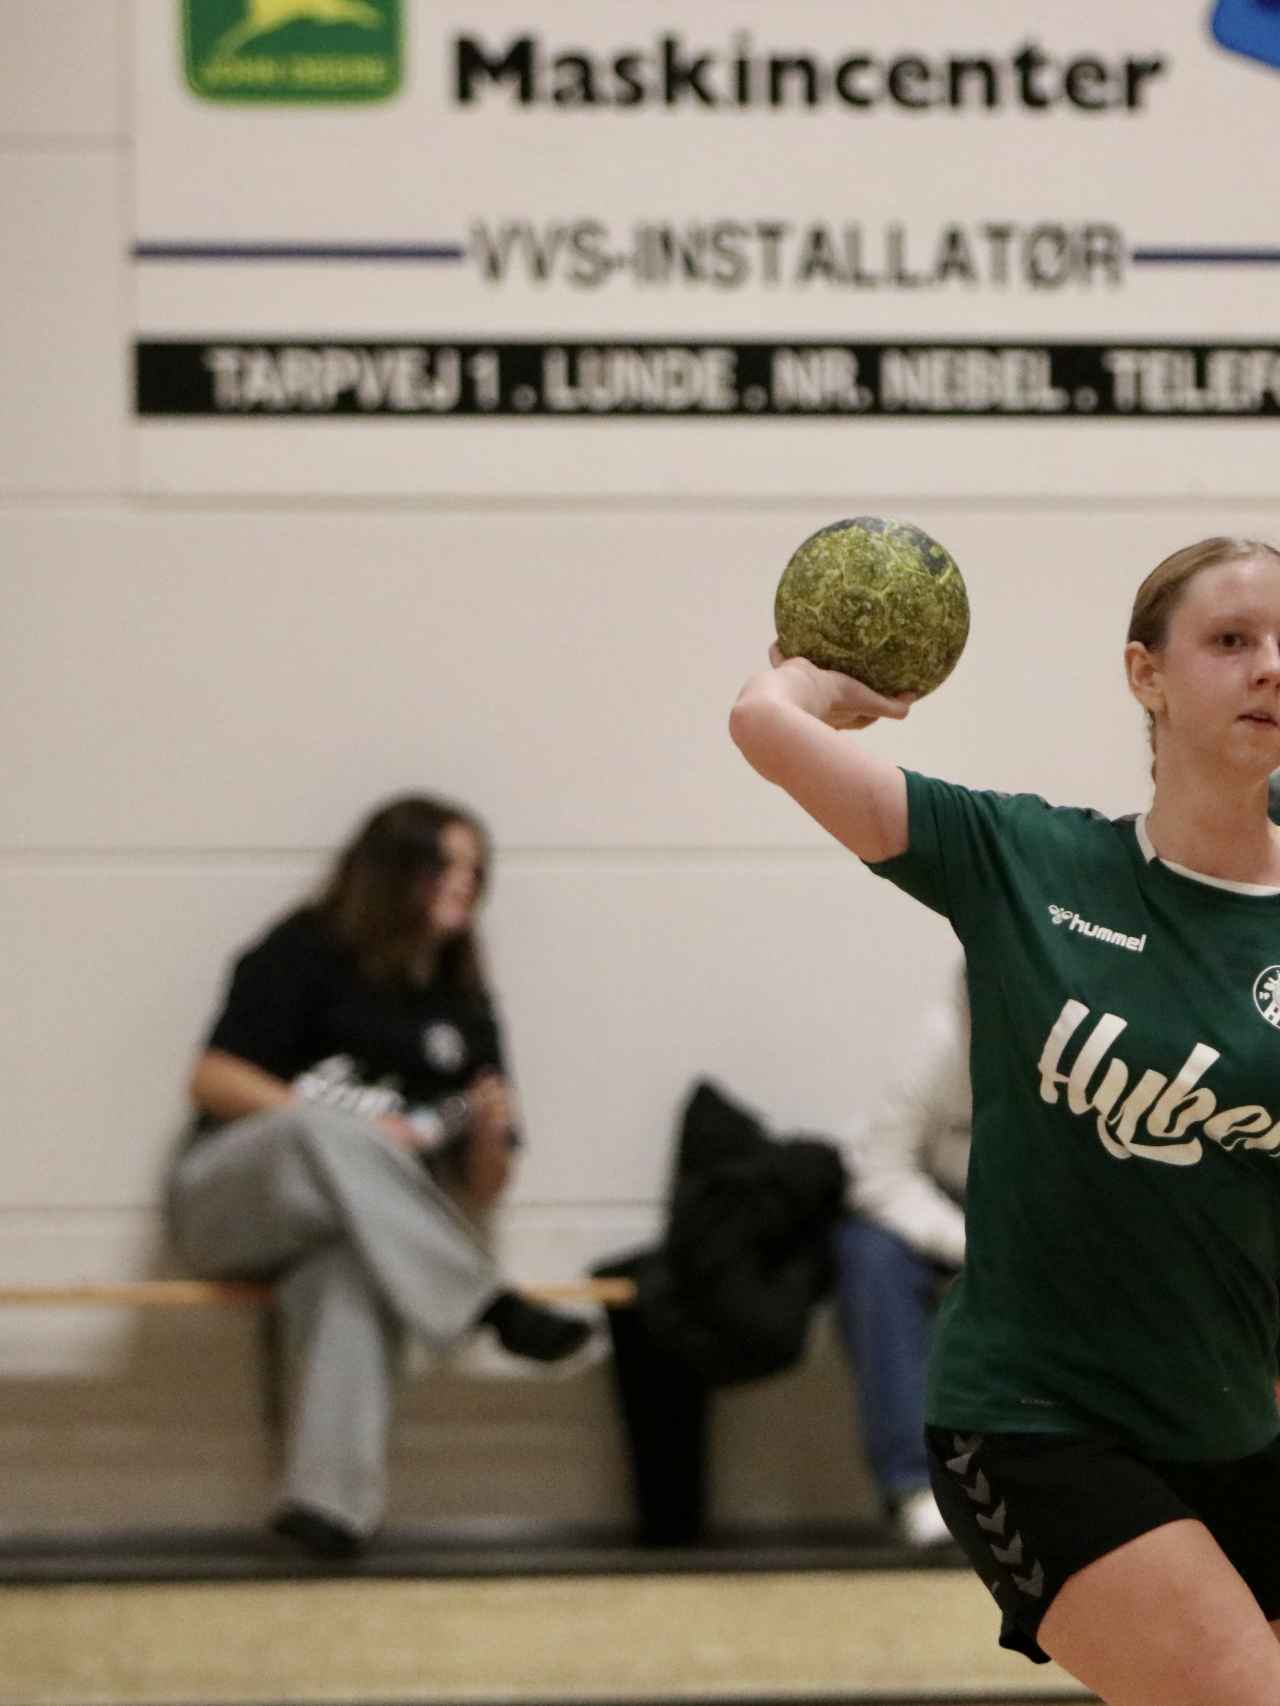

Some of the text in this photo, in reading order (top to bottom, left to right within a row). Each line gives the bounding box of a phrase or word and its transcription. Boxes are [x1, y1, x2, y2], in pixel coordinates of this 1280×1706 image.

[455, 33, 1166, 109] Maskincenter
[472, 219, 1127, 290] VVS-INSTALLATØR
[542, 348, 736, 411] LUNDE
[773, 348, 873, 411] NR.
[880, 348, 1068, 411] NEBEL
[1069, 914, 1147, 952] hummel
